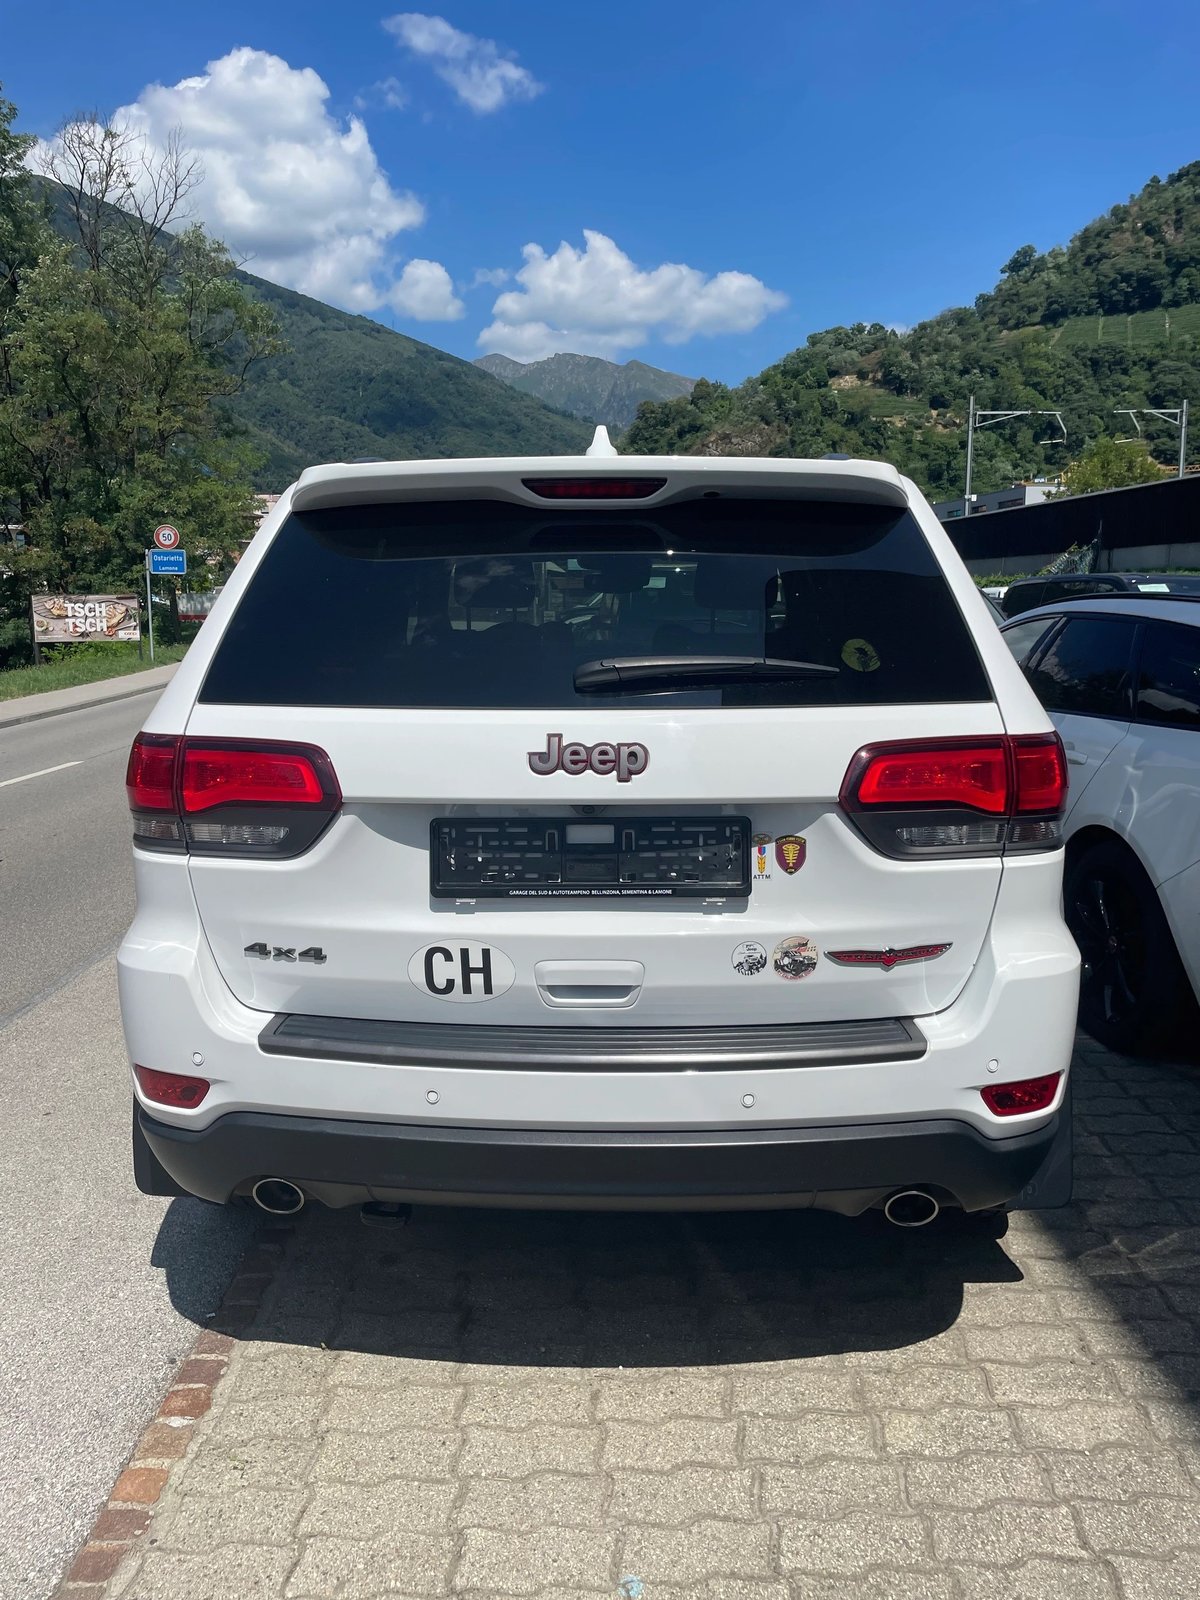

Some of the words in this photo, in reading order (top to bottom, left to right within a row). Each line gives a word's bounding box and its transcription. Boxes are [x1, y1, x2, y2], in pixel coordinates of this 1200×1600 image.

[162, 533, 172, 541] 50
[153, 554, 183, 562] Ostarietta
[64, 603, 107, 617] TSCH
[66, 618, 108, 632] TSCH
[528, 733, 649, 782] Jeep
[244, 941, 328, 962] 4x4
[423, 946, 494, 996] CH
